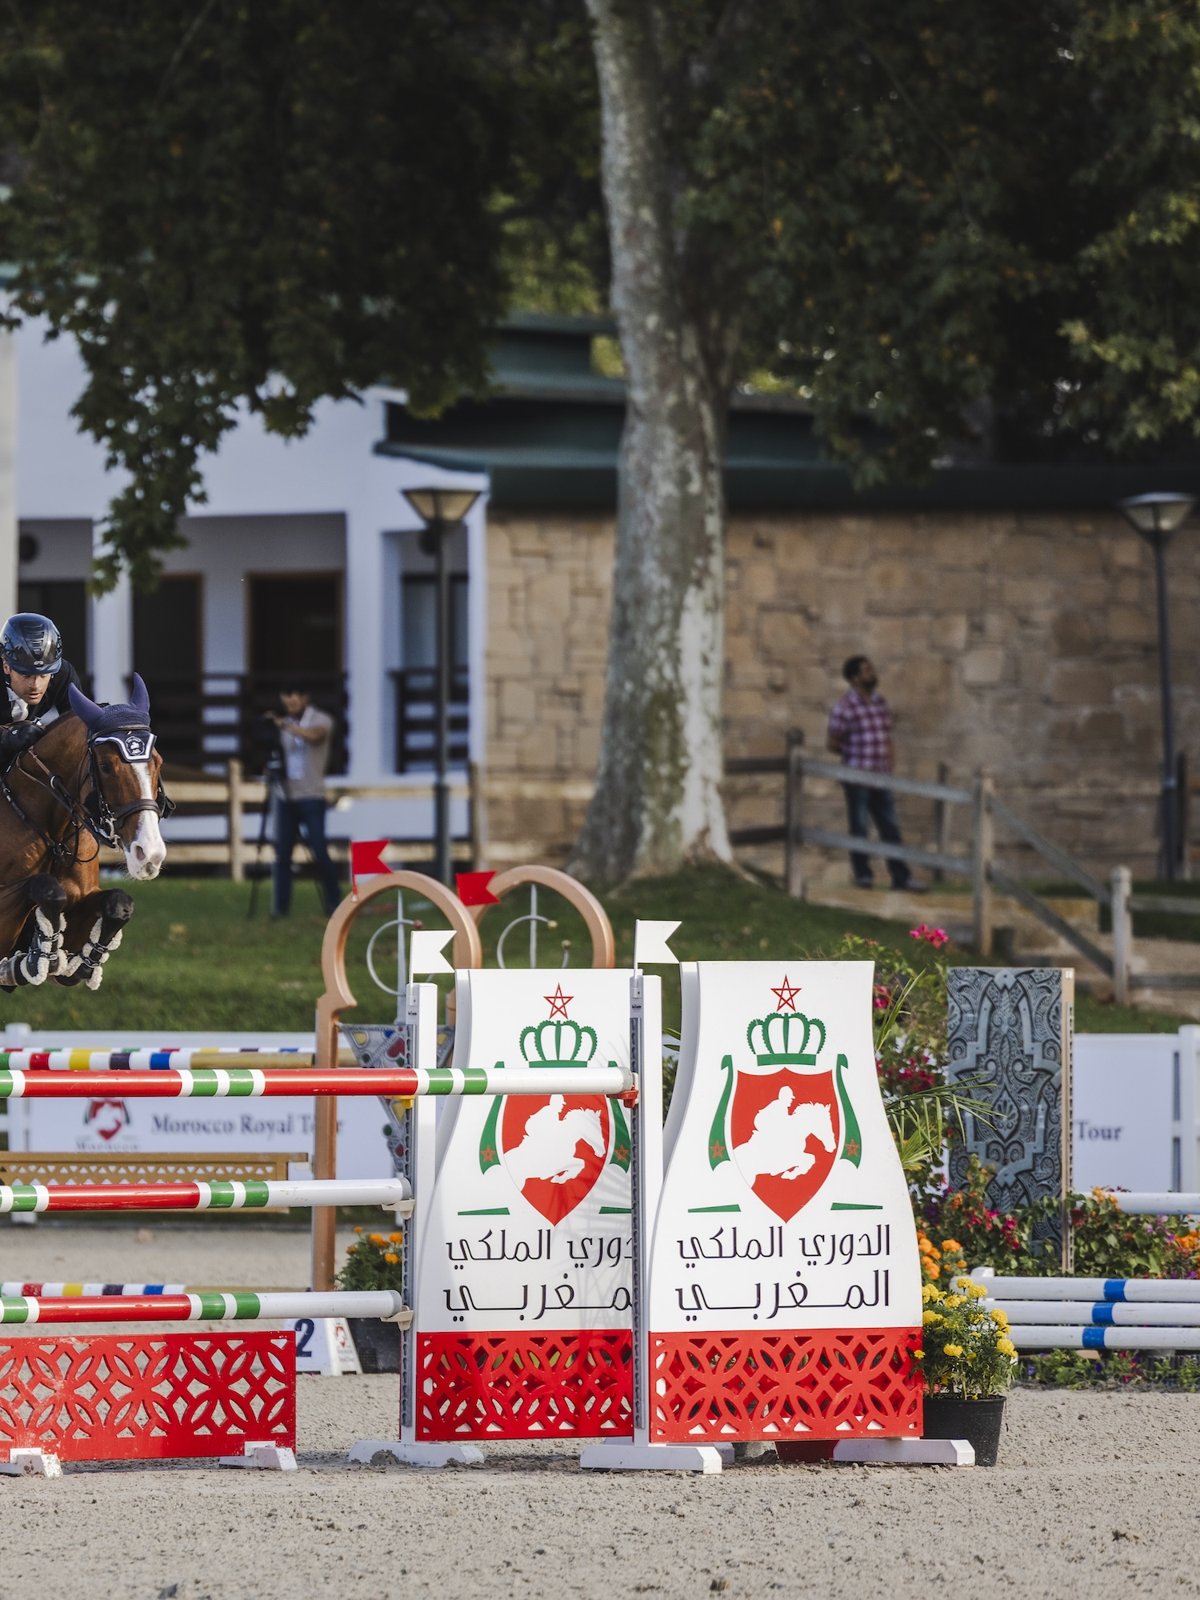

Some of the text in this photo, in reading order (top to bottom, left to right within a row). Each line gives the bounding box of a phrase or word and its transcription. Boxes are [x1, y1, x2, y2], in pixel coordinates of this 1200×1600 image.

[151, 1112, 344, 1139] Morocco Royal Tr
[1074, 1119, 1122, 1141] Tour
[445, 1228, 551, 1270] الملكي
[676, 1223, 890, 1269] الدوري الملكي
[294, 1317, 315, 1358] 2
